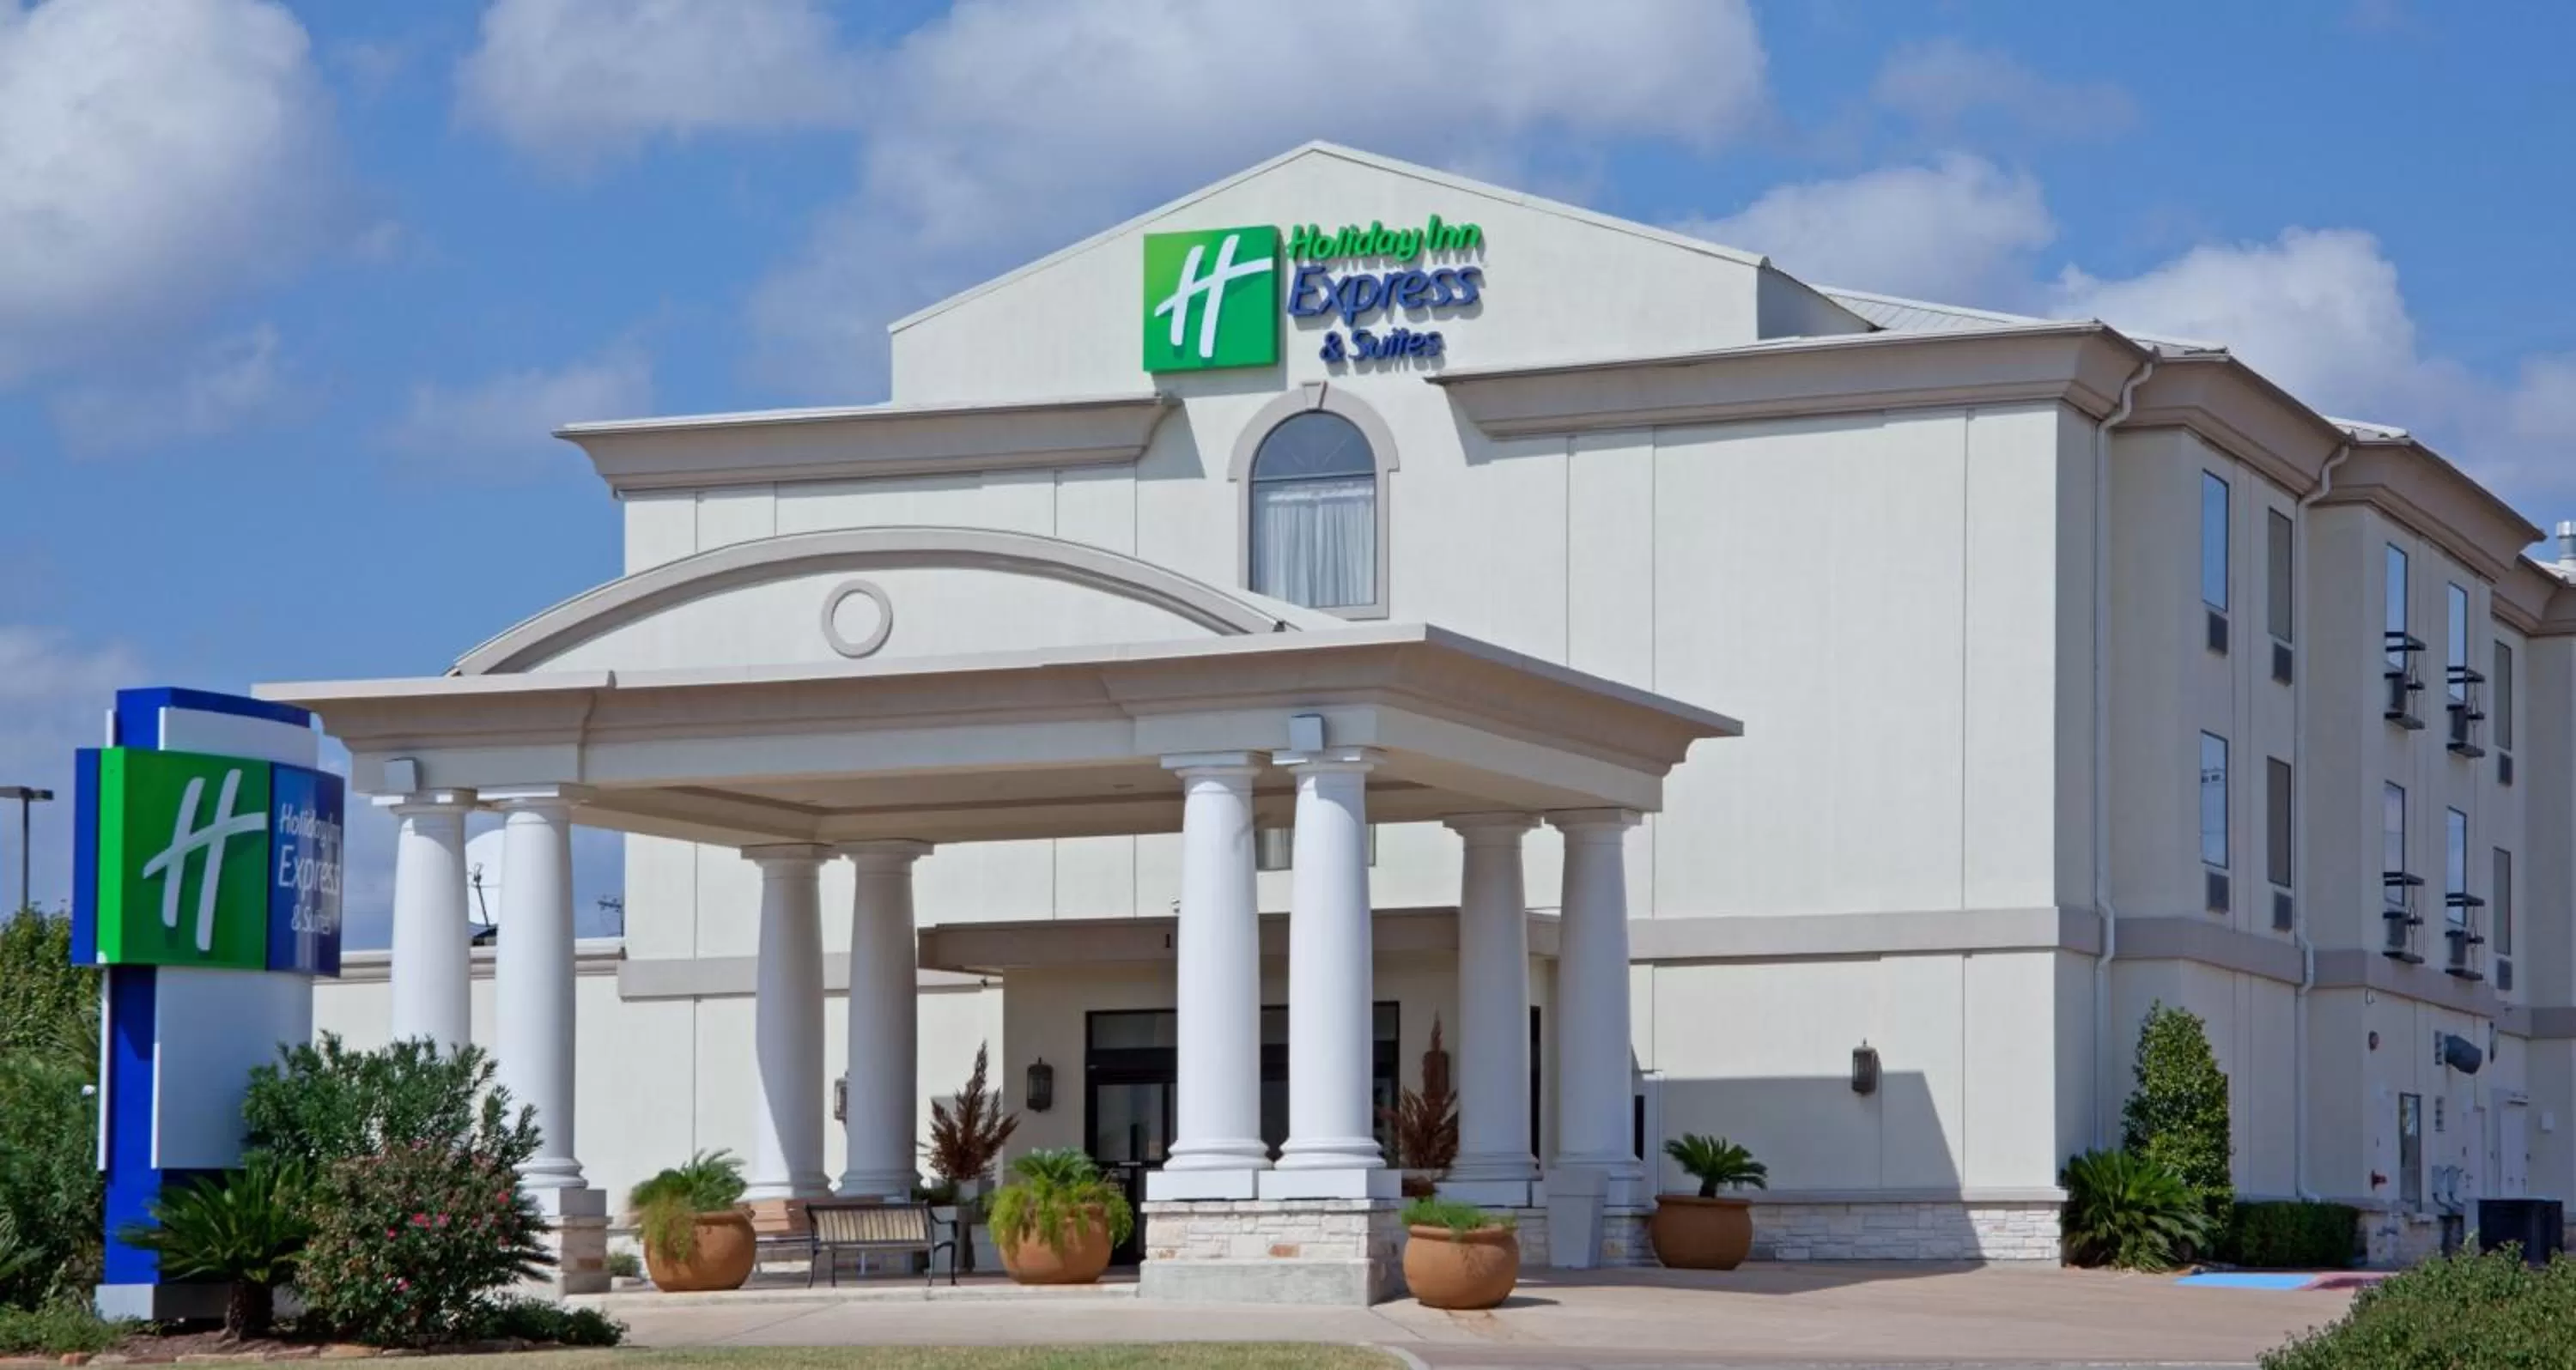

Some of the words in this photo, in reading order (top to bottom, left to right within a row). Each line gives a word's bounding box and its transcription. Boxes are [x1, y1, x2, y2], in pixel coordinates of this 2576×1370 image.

[1287, 220, 1423, 262] Holiday
[1425, 214, 1481, 251] Inn
[1287, 265, 1483, 327] Express
[1320, 331, 1344, 362] &
[1348, 327, 1446, 361] Suites
[278, 845, 341, 901] Express
